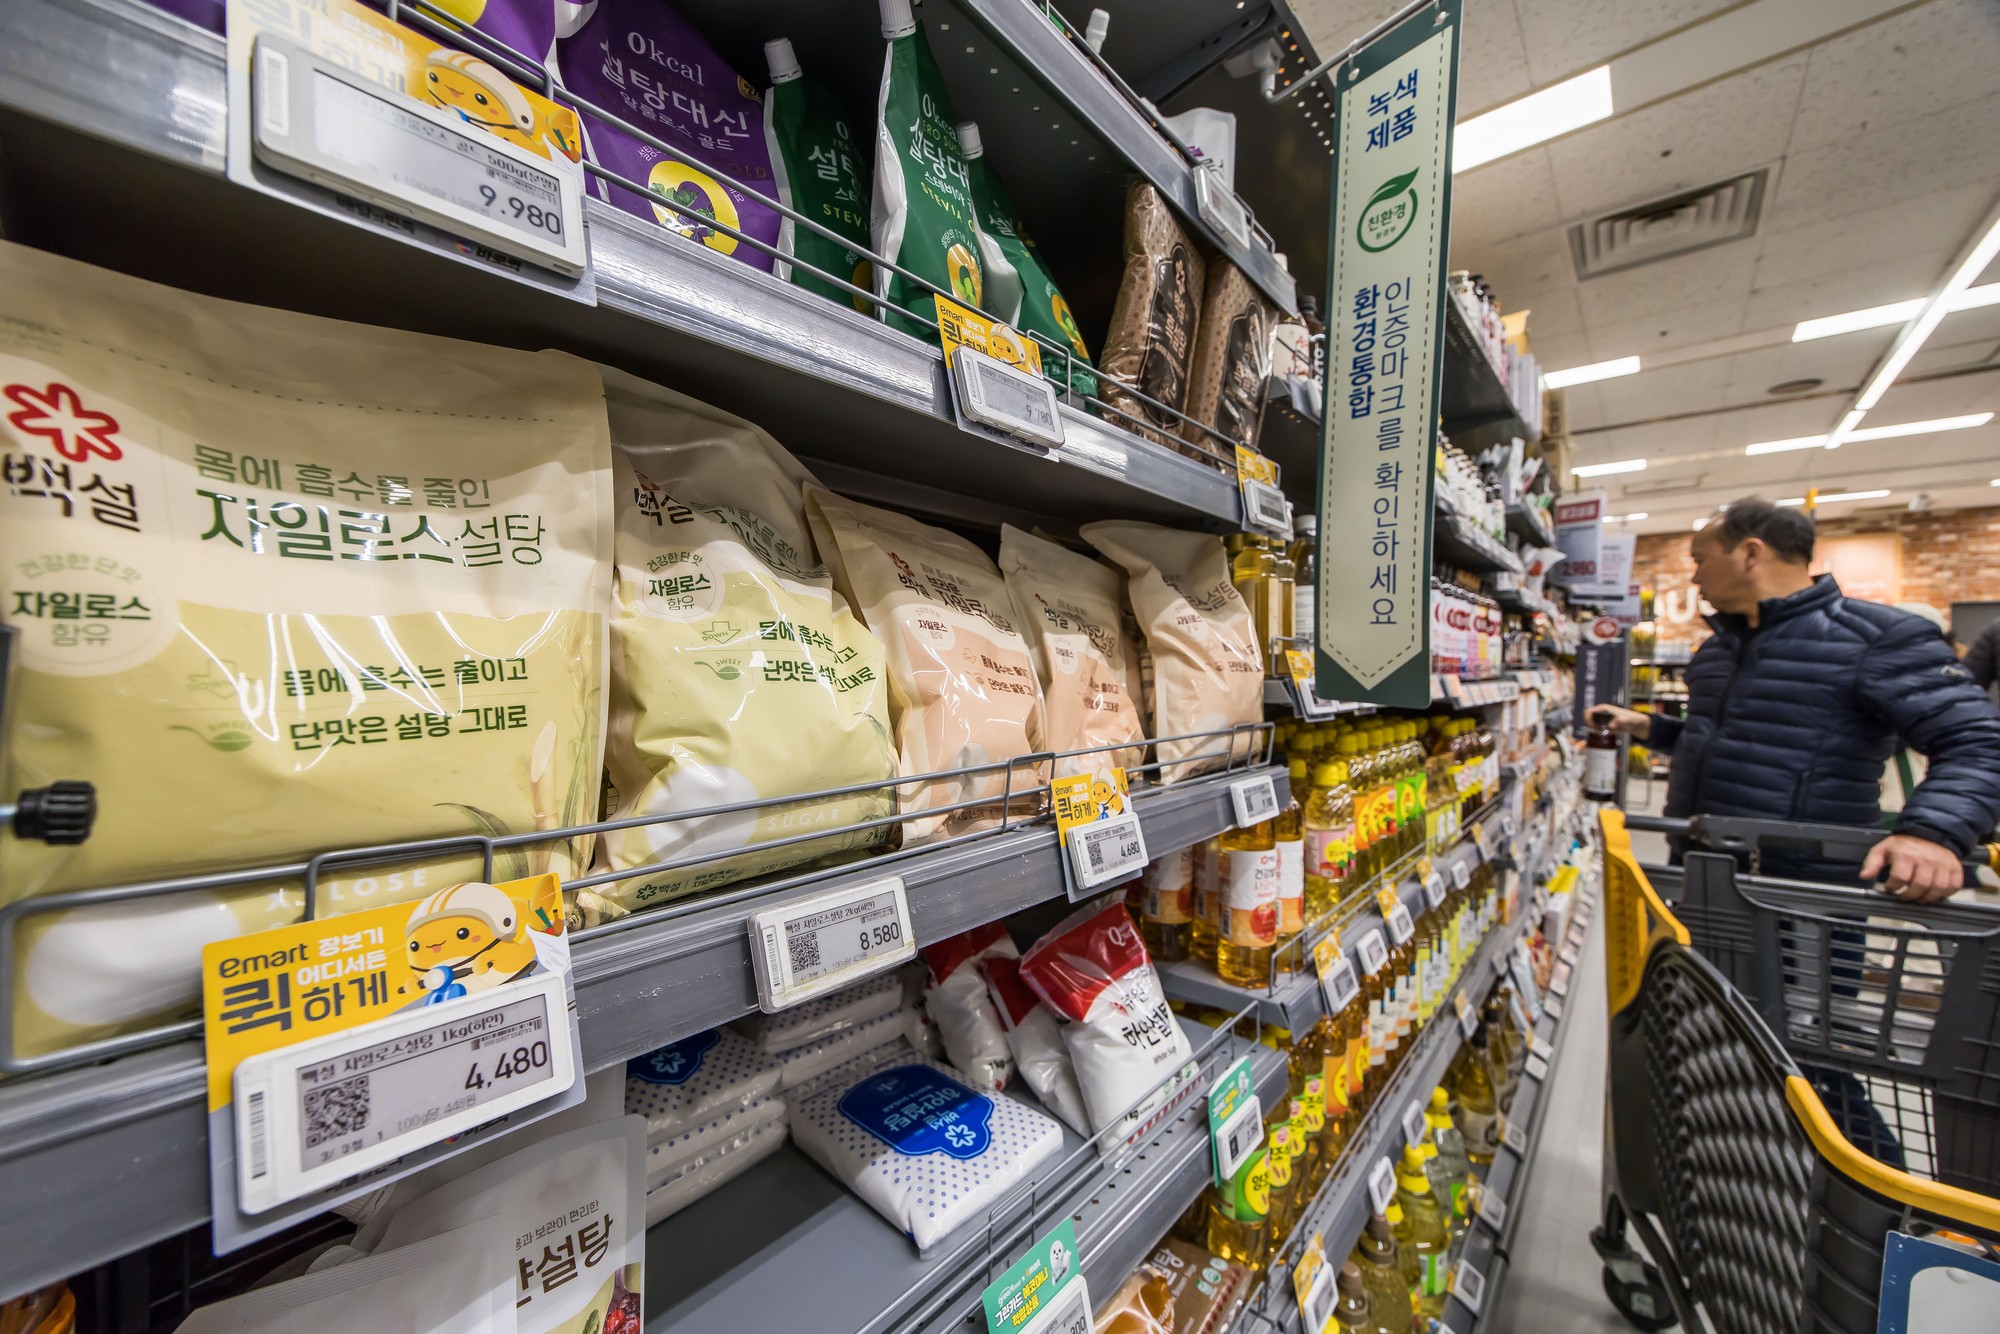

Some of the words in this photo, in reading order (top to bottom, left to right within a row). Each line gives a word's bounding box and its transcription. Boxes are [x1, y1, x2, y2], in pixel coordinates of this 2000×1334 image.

[628, 32, 704, 86] 0kcal
[1366, 68, 1418, 118] 녹색
[620, 91, 693, 138] 알룰로스
[698, 133, 734, 151] 골드
[922, 93, 957, 141] 0kca
[1365, 105, 1417, 153] 제품
[909, 117, 970, 192] 설탕대
[920, 182, 963, 224] STEVIA
[1367, 201, 1407, 231] 친환경
[939, 304, 965, 325] emart
[1349, 284, 1380, 419] 환경통합
[1375, 276, 1411, 452] 인증마크를
[1, 453, 142, 533] 백설
[194, 443, 283, 491] 몸에
[295, 462, 413, 506] 흡수를
[423, 476, 492, 510] 줄인
[1369, 461, 1403, 625] 확인하세요
[646, 552, 679, 573] 건강한
[648, 573, 711, 598] 자일로스
[667, 595, 695, 611] 함유
[898, 572, 933, 601] 백설
[926, 574, 963, 597] 브라운
[11, 591, 152, 620] 자일로스
[52, 623, 110, 647] 함유
[702, 631, 729, 642] DOWN
[759, 620, 795, 641] 몸에
[917, 619, 949, 633] 자일로스
[282, 667, 348, 697] 몸에
[359, 665, 446, 692] 흡수는
[454, 656, 529, 686] 줄이고
[715, 658, 741, 667] SWEET
[763, 660, 818, 682] 단맛은
[290, 714, 387, 751] 단맛은
[394, 712, 452, 741] 설탕
[458, 704, 529, 734] 그대로
[1055, 785, 1073, 796] emart
[1058, 796, 1073, 821] 퀵
[768, 808, 840, 832] SUGAR
[1073, 801, 1092, 819] 하게
[267, 869, 428, 912] XLOSE
[659, 882, 682, 895] 백설
[318, 926, 384, 958] 장보기
[859, 921, 900, 951] 8,580
[219, 942, 309, 979] emart
[296, 949, 387, 988] 어디서든
[219, 971, 293, 1035] 퀵
[301, 971, 388, 1023] 하게
[464, 1040, 548, 1091] 4,480
[882, 1087, 961, 1132] 하얀설탕
[535, 1214, 566, 1240] 보관이
[569, 1199, 599, 1222] 편리한
[995, 1292, 1024, 1328] 그린카드
[1022, 1266, 1049, 1299] 에코머니
[1011, 1294, 1040, 1327] 적립상품
